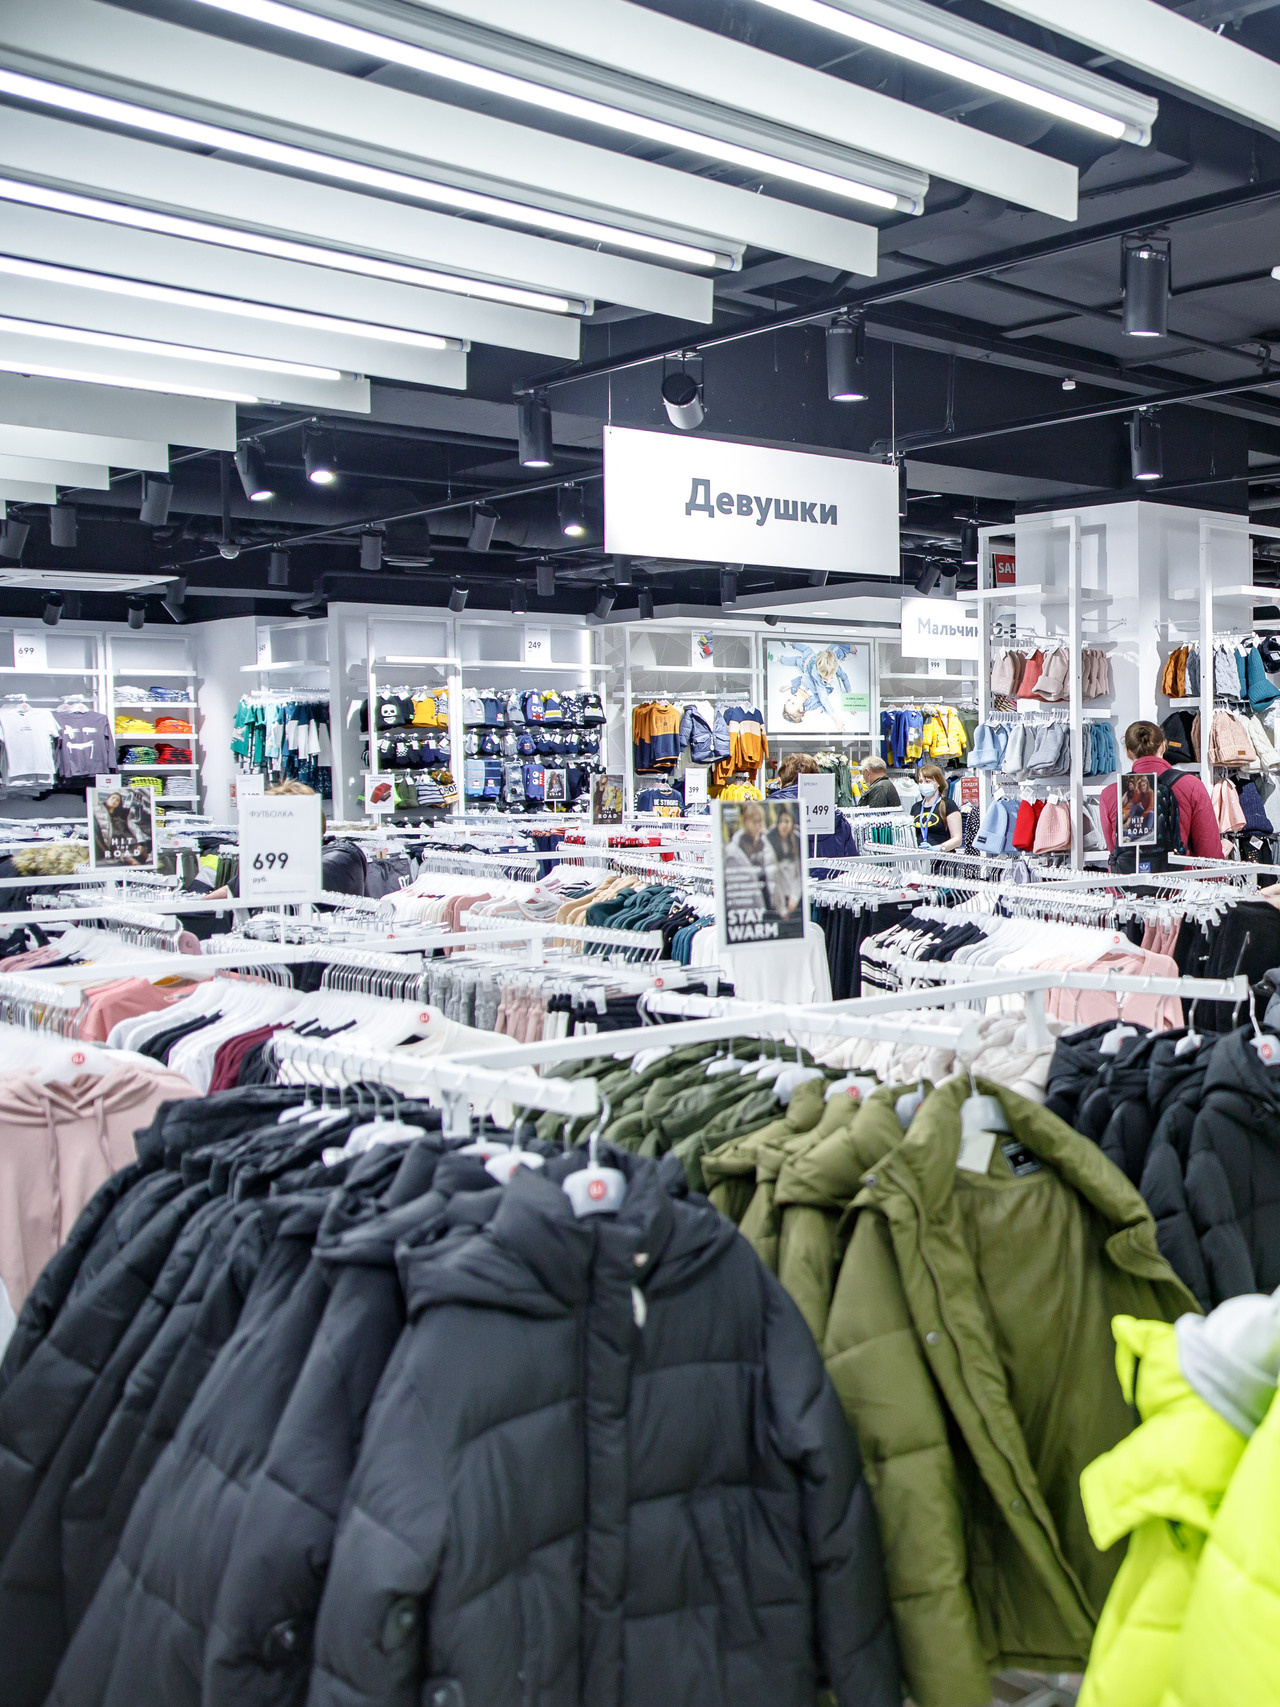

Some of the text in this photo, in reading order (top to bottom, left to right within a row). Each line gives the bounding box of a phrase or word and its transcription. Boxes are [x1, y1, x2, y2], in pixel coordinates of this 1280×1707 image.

[685, 478, 837, 526] Девушки
[917, 617, 978, 637] Мальчи
[249, 810, 294, 818] ФУТБОЛКА
[812, 806, 829, 815] 499
[111, 837, 133, 846] HIT
[104, 849, 141, 858] ROAD
[252, 852, 289, 870] 699
[252, 876, 268, 884] руб.
[727, 908, 766, 924] STAY
[727, 922, 779, 941] WARM
